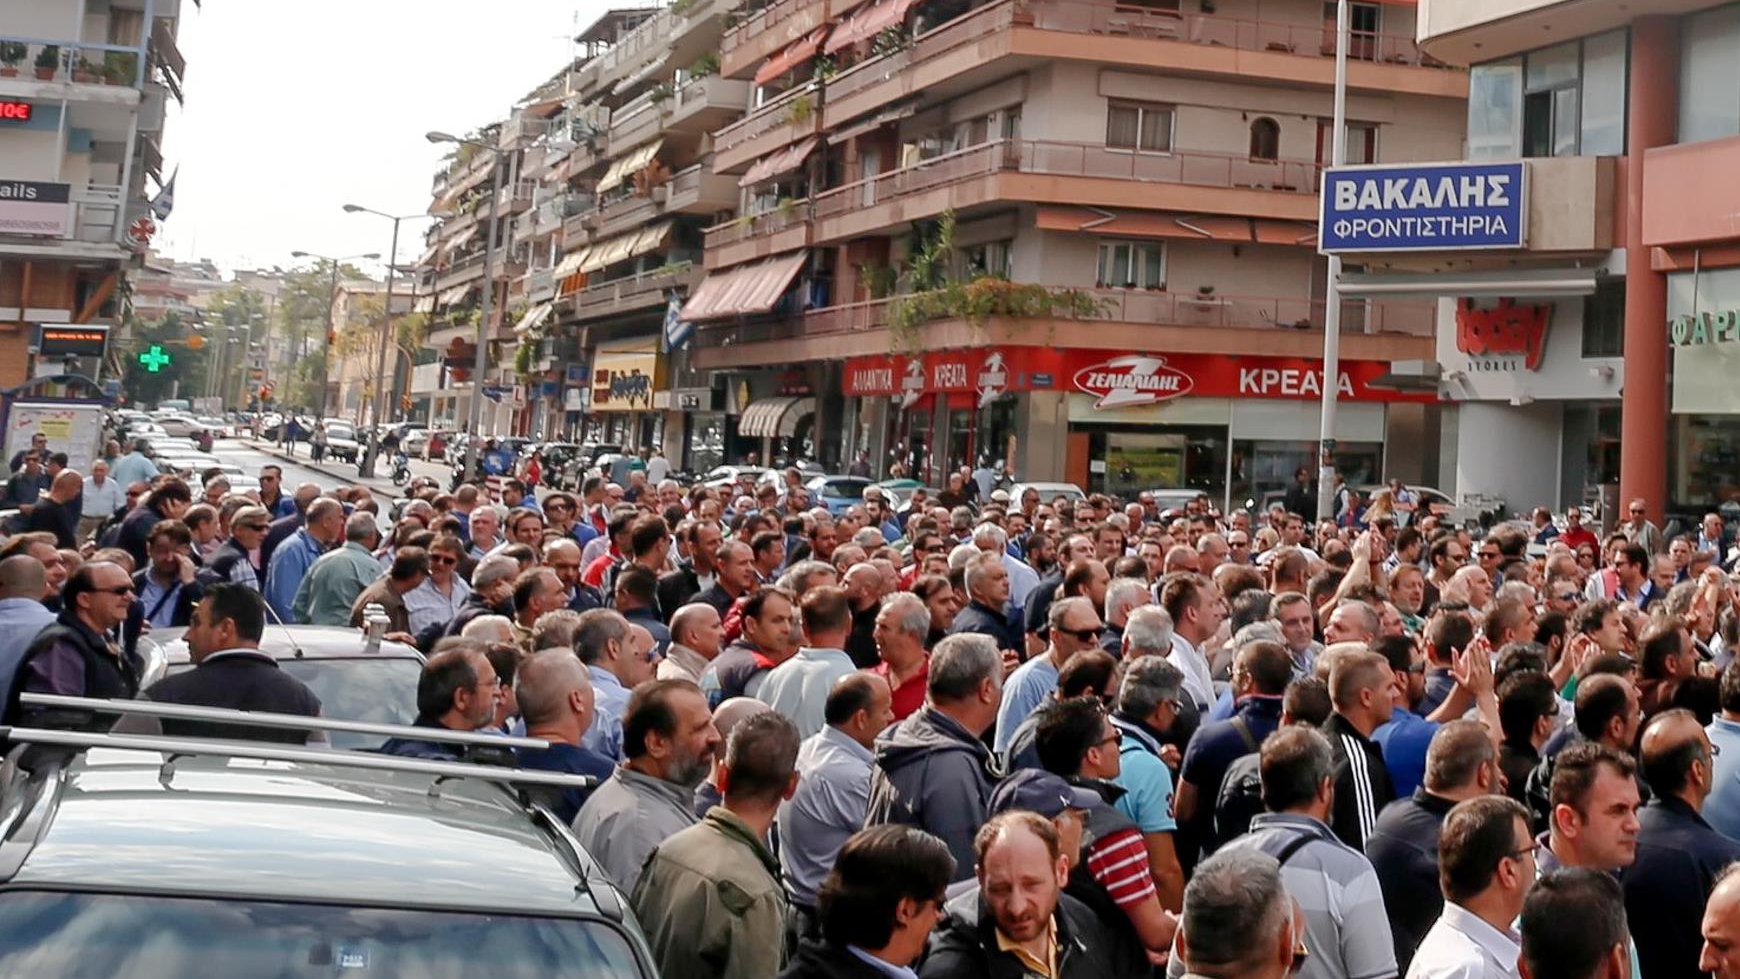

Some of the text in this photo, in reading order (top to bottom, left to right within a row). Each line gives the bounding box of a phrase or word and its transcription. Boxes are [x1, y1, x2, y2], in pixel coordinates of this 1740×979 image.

[1334, 174, 1511, 211] ΒΑΚΑΛΗΣ
[1333, 214, 1508, 239] ΦΡΟΝΤΙΣΤΗΡΙΑ
[1240, 367, 1355, 397] ΚΡΕΑΑ
